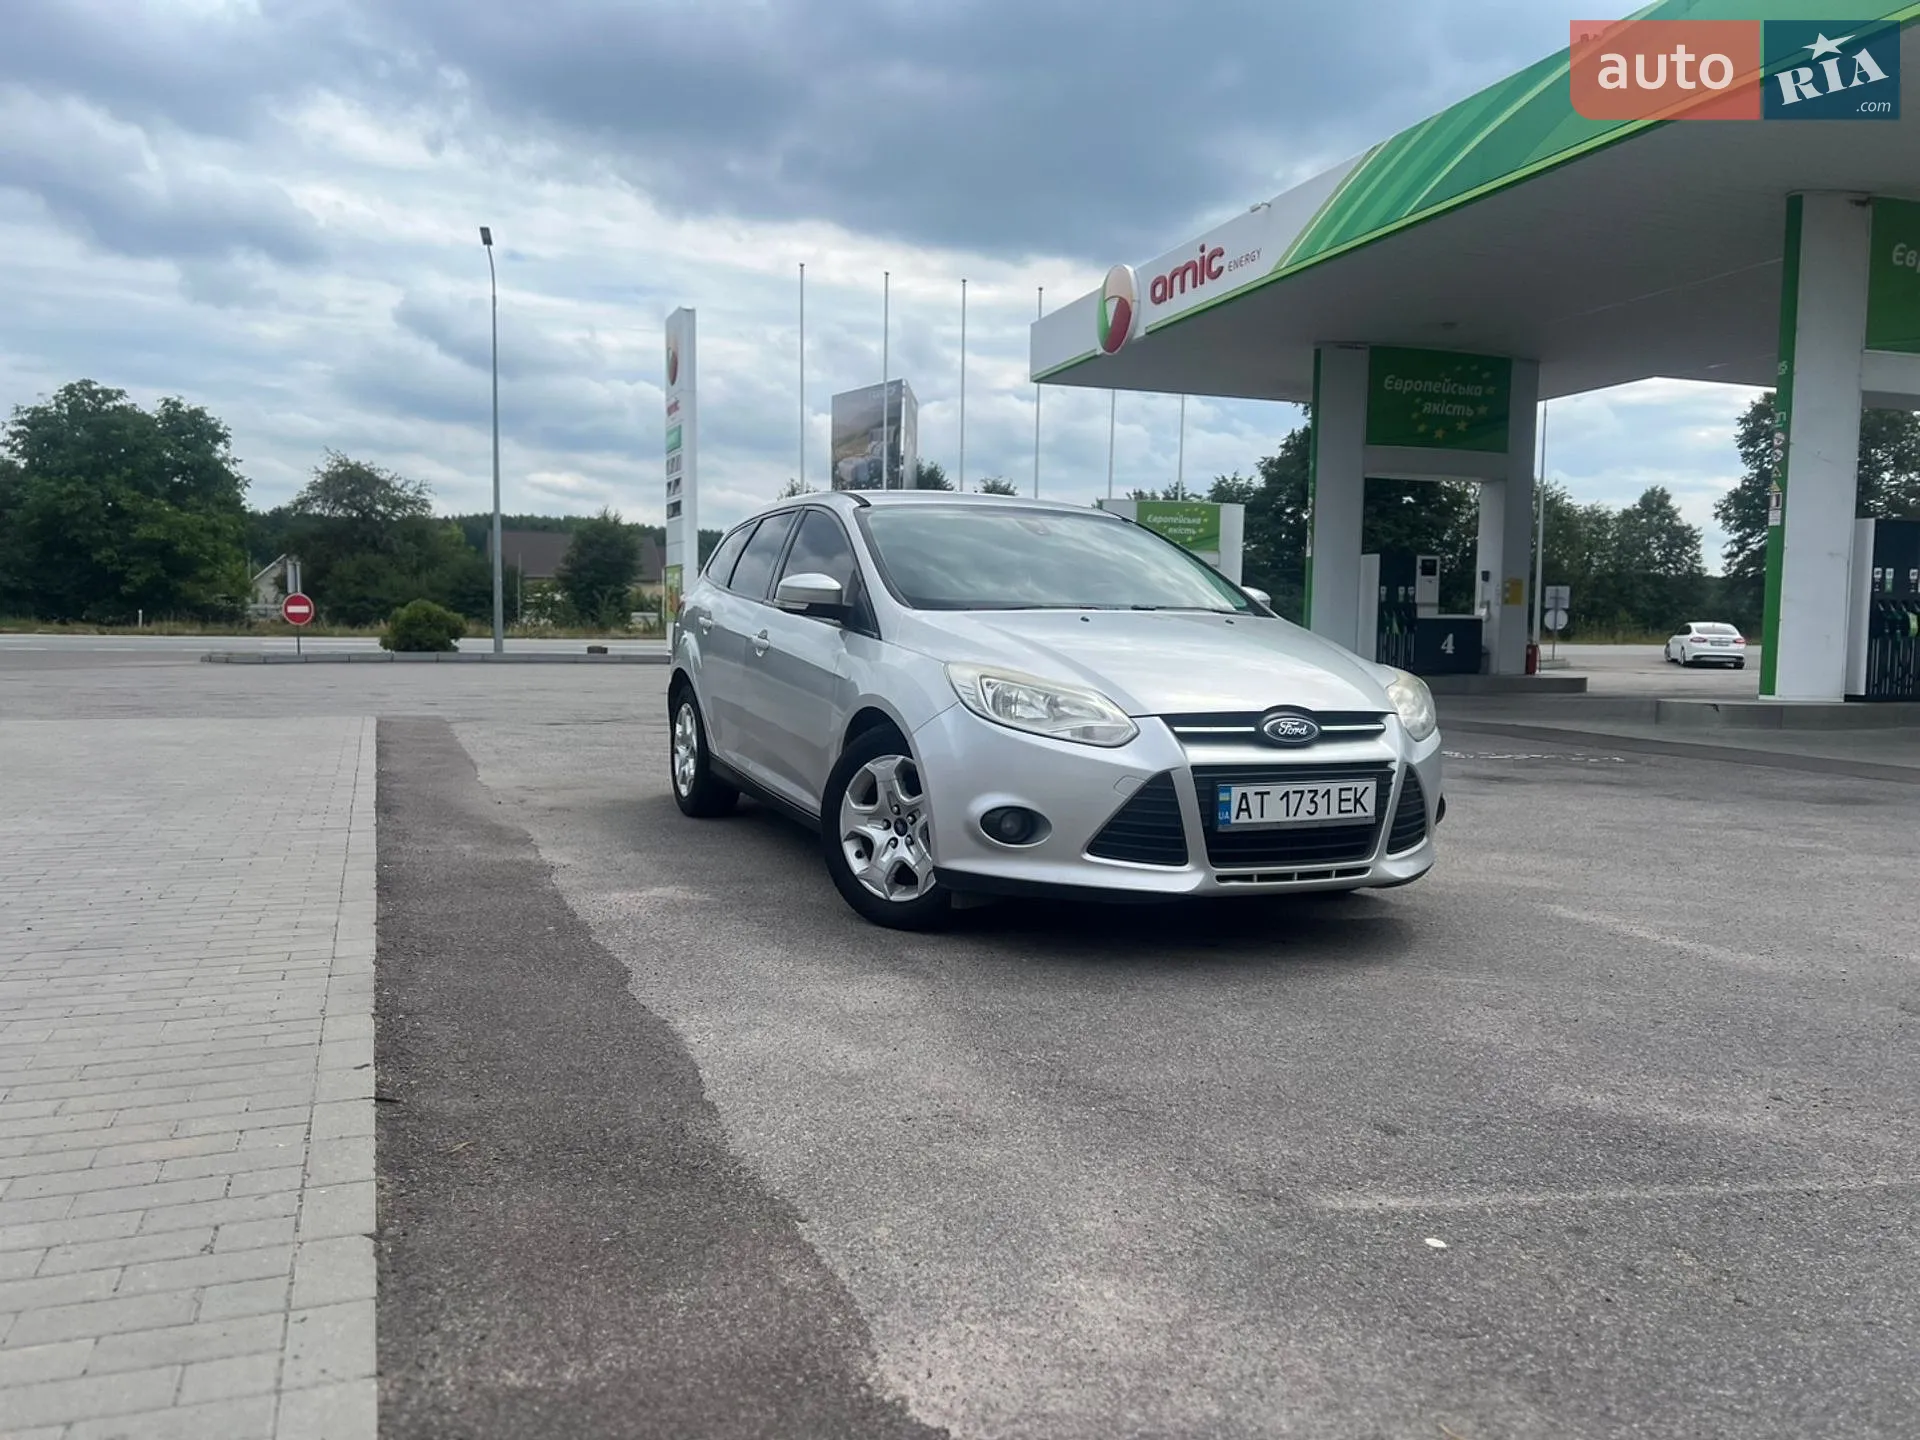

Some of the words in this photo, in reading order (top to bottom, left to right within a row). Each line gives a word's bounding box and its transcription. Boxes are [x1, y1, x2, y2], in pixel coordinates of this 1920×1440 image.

[1150, 244, 1225, 305] amic
[1228, 248, 1263, 272] ENERGY
[1384, 373, 1483, 396] Європейська
[1422, 399, 1474, 417] якість
[1441, 633, 1455, 654] 4
[1278, 721, 1308, 735] Ford
[1219, 811, 1230, 820] UA
